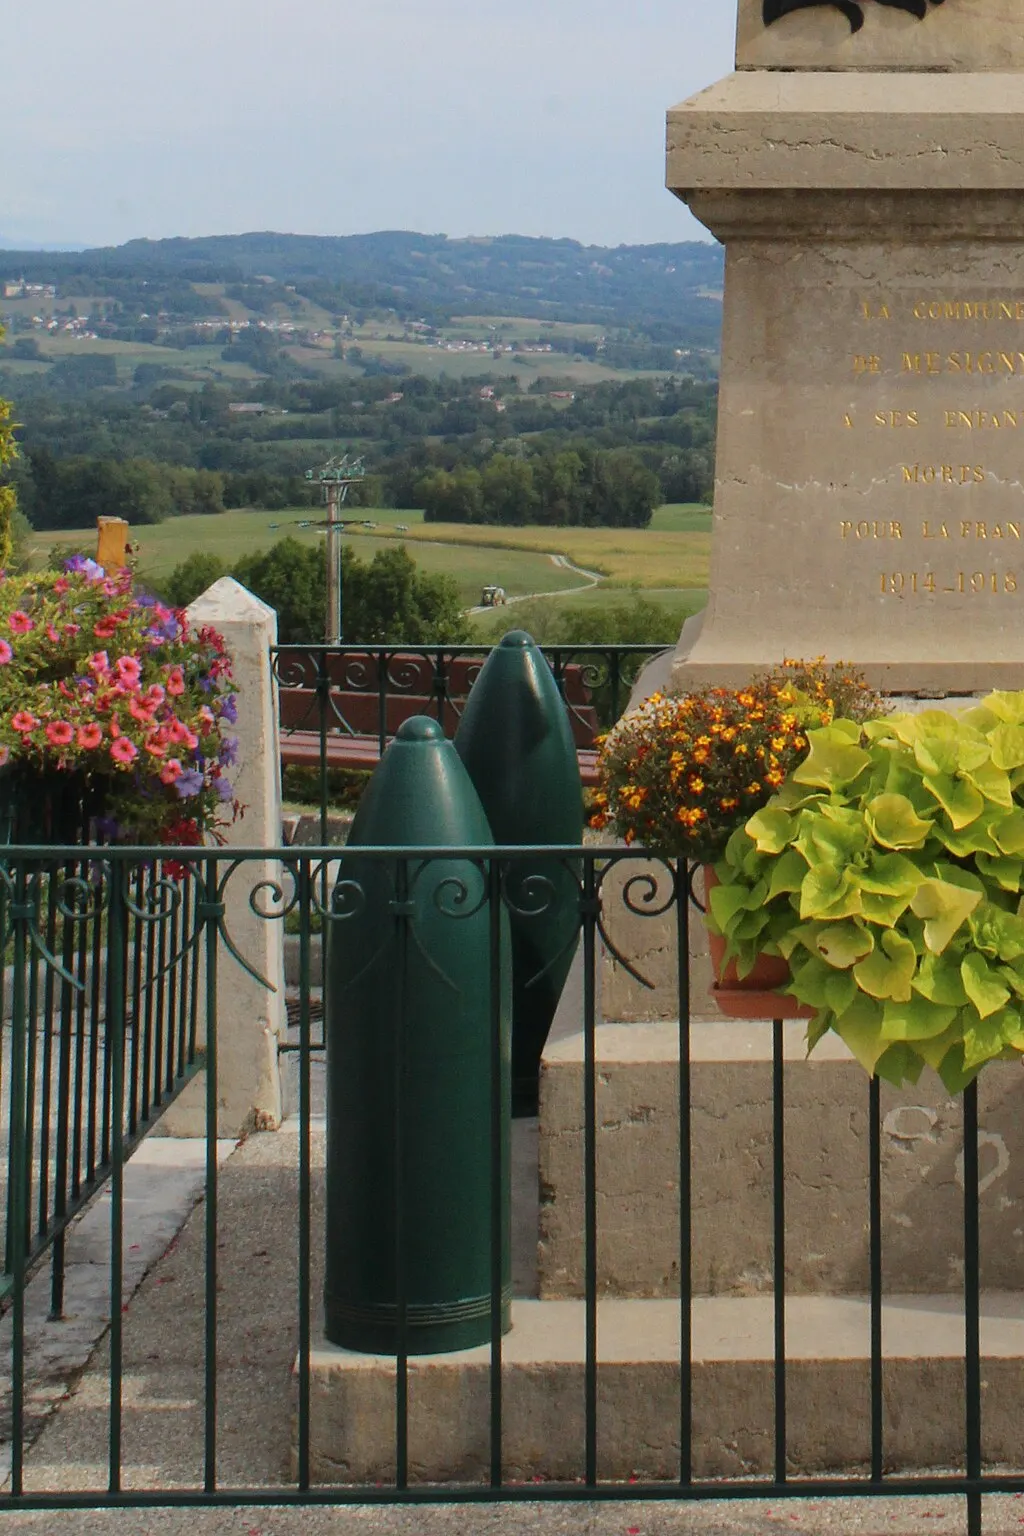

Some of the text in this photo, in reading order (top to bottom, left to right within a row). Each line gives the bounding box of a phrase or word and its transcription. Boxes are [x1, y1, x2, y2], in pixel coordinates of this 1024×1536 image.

[862, 301, 890, 321] LA
[851, 353, 882, 375] DE
[841, 412, 854, 429] A
[874, 409, 919, 428] SES
[901, 463, 985, 485] MORTS
[840, 520, 903, 540] POUR
[921, 520, 950, 540] LA
